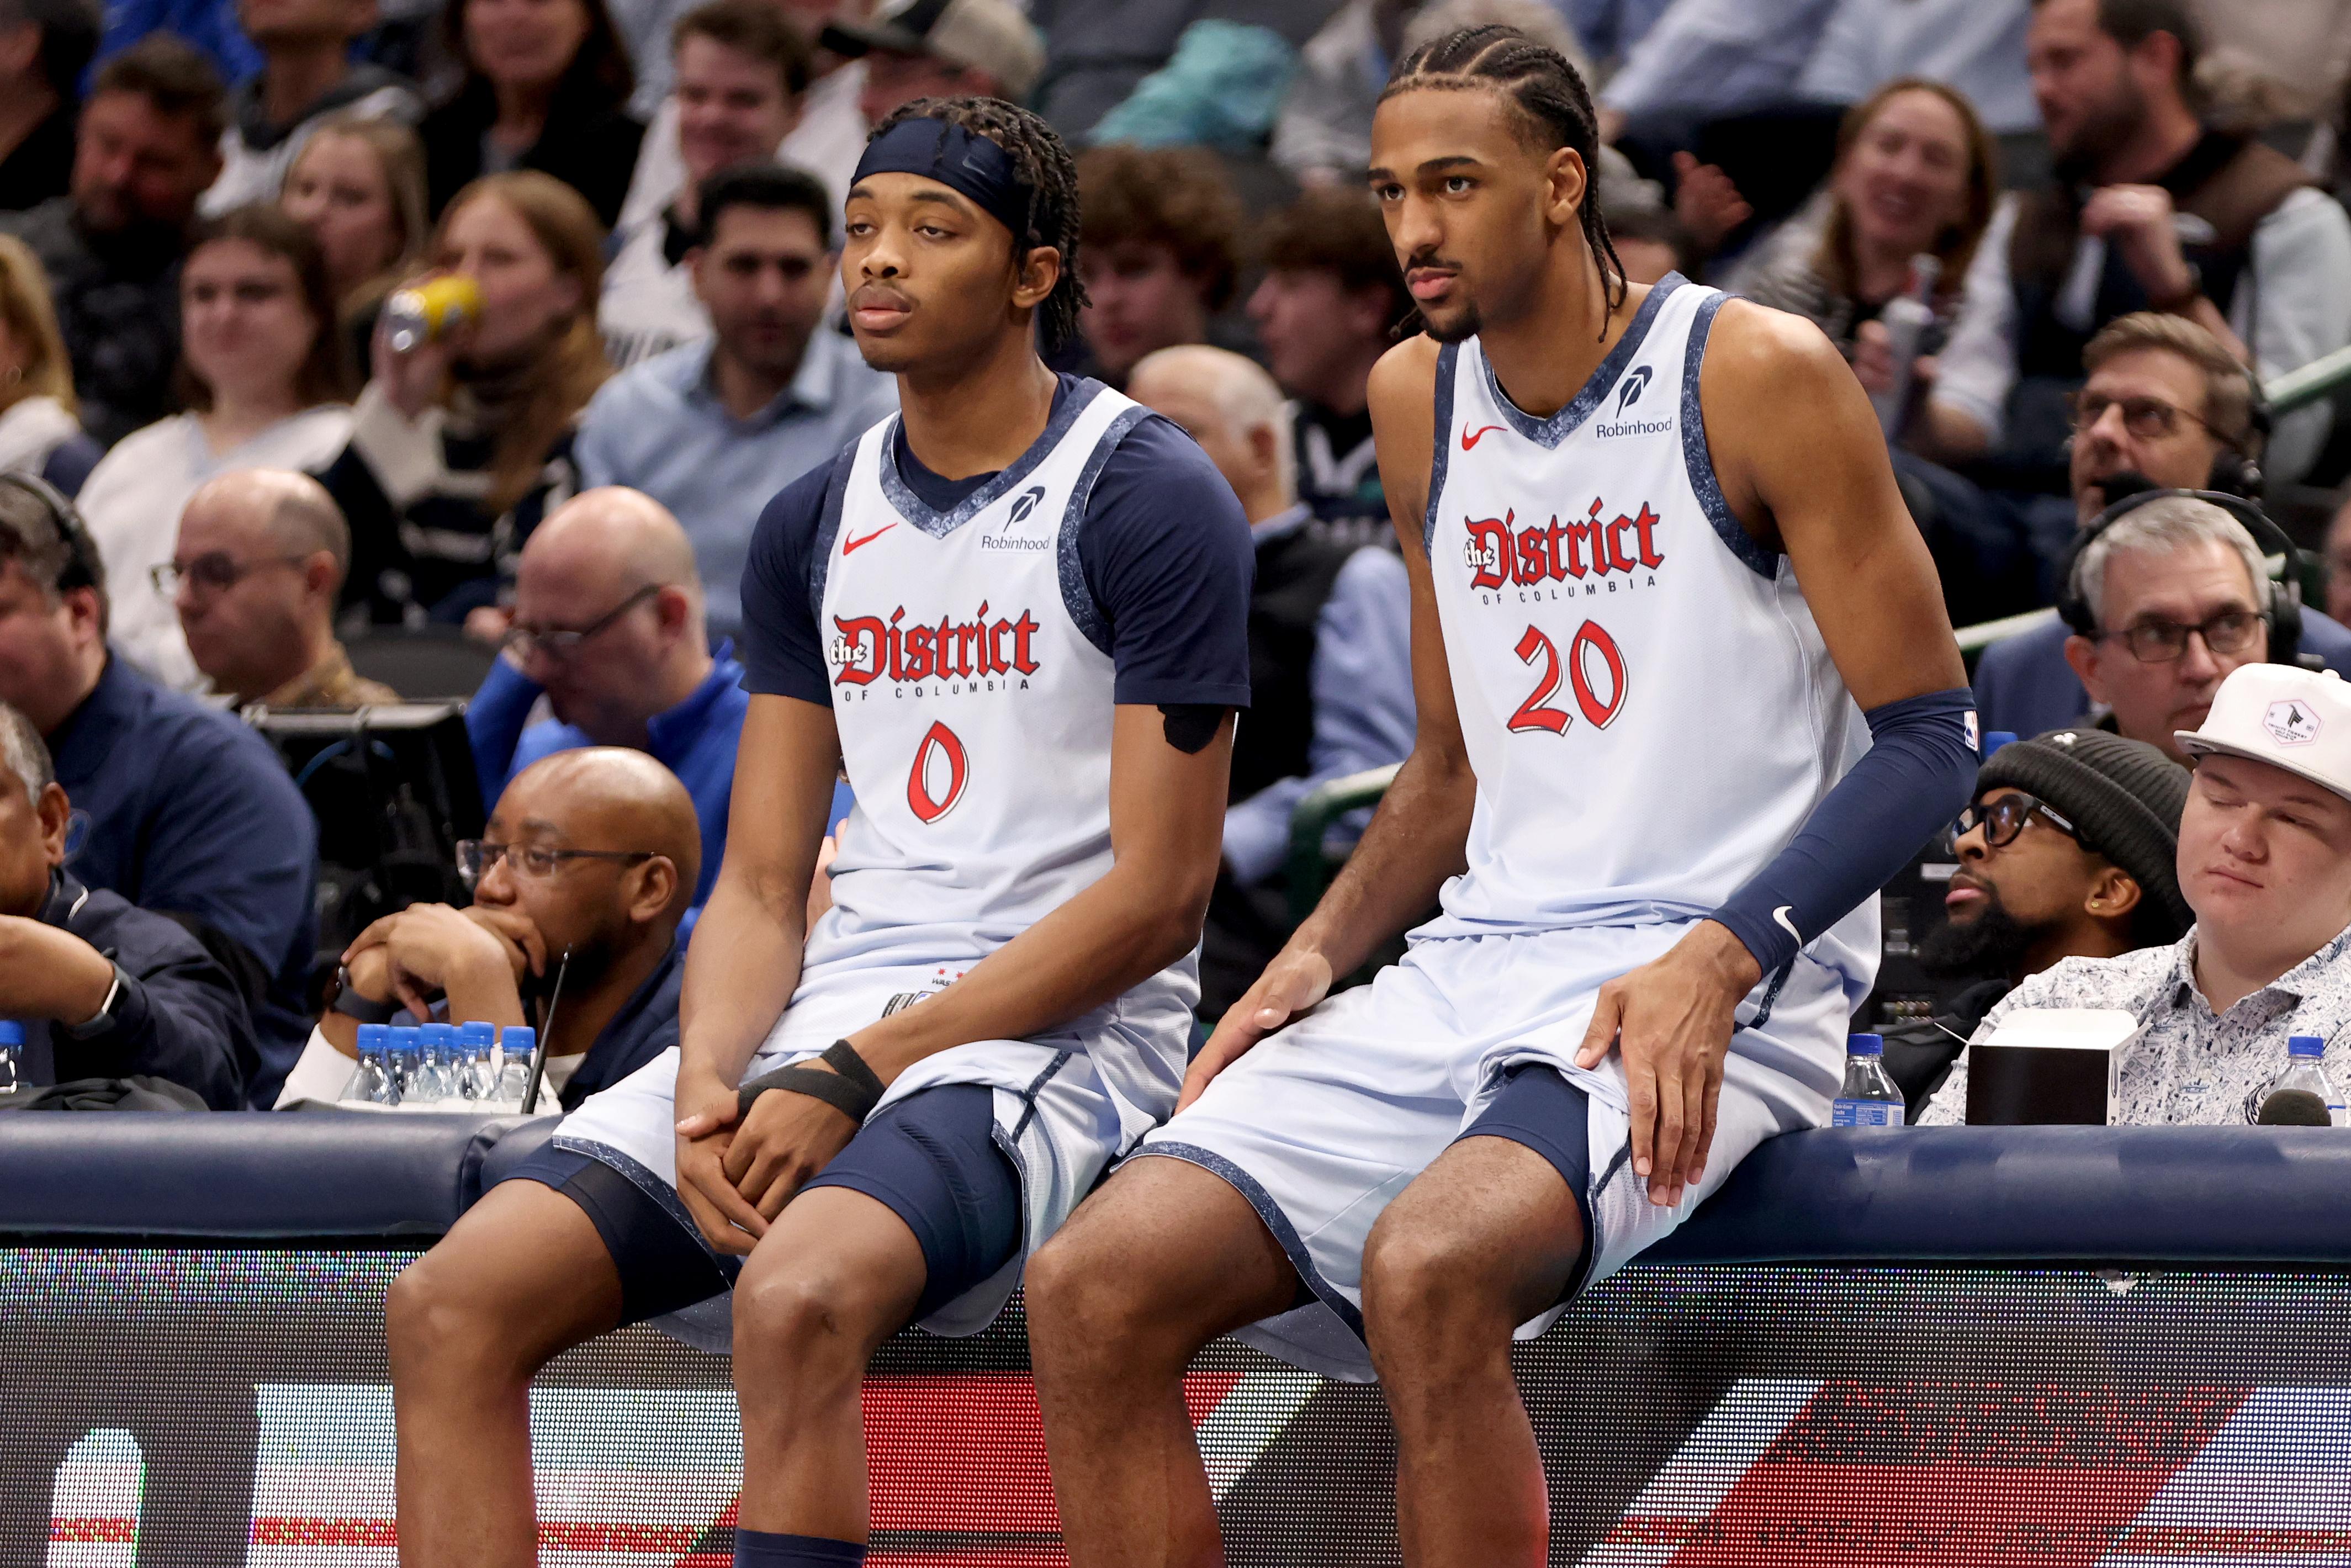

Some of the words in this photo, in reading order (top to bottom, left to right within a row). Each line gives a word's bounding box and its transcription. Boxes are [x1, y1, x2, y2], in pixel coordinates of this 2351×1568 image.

[1596, 416, 1672, 438] Robinhood
[981, 536, 1050, 550] Robinhood
[1464, 496, 1665, 591] District
[1464, 538, 1495, 568] the
[1482, 594, 1502, 605] OF
[1519, 575, 1656, 602] COLUMBIA
[829, 635, 867, 665] the
[833, 599, 1040, 687] District
[844, 690, 869, 702] OF
[894, 679, 1029, 699] COLUMBIA
[1506, 619, 1629, 737] 20
[907, 720, 969, 824] 0
